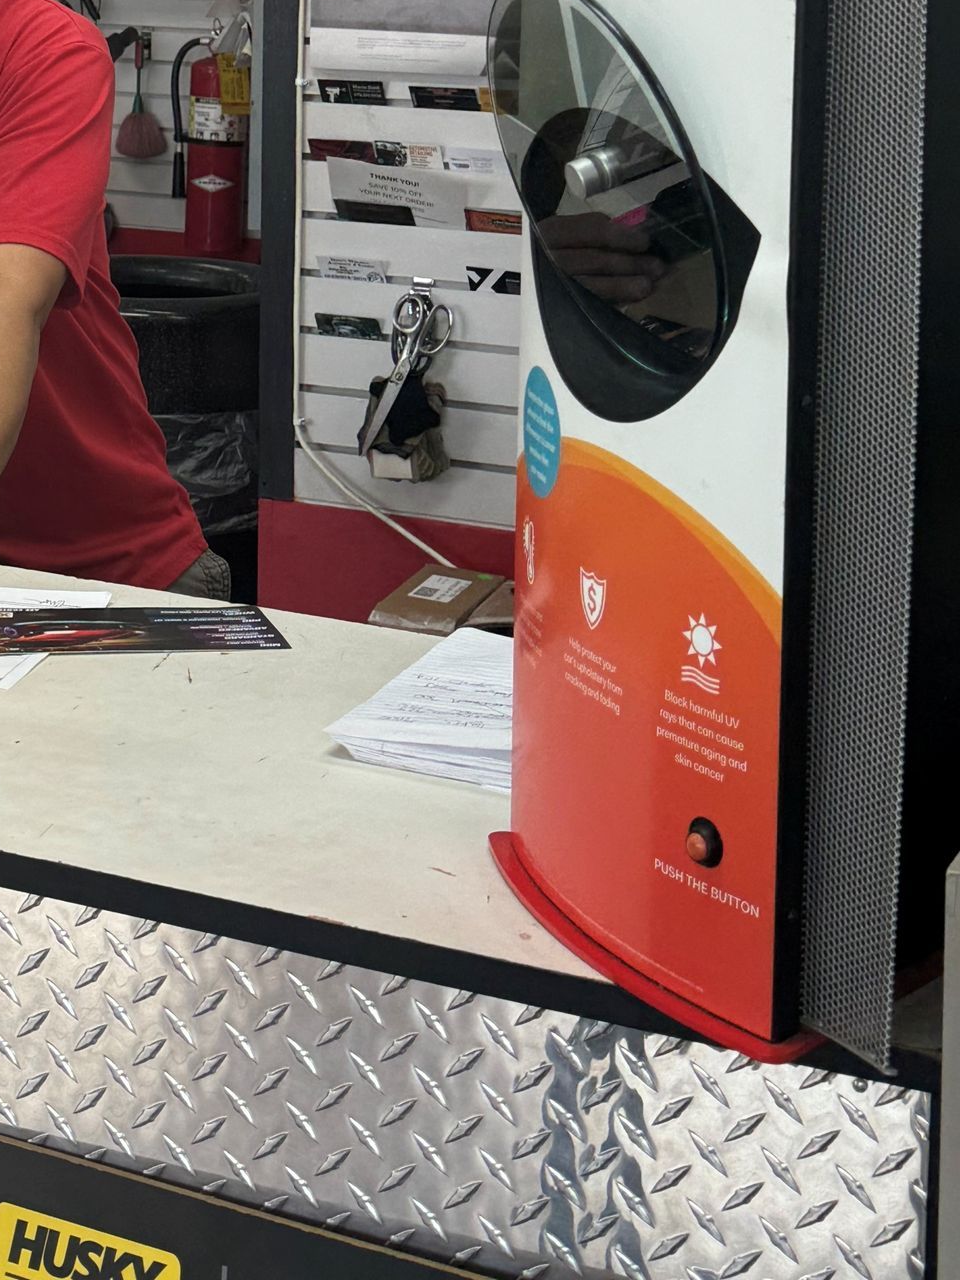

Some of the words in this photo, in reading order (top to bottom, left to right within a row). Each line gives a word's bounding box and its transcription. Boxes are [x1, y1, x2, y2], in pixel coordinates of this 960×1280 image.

[660, 708, 678, 723] rays
[678, 716, 697, 731] that
[698, 726, 714, 739] can
[716, 733, 744, 751] cause
[664, 689, 689, 709] Block
[689, 700, 724, 723] harmful
[726, 714, 740, 729] UV
[656, 726, 700, 753] premature
[701, 746, 727, 767] aging
[728, 758, 747, 773] and
[674, 753, 693, 769] skin
[694, 762, 725, 783] cancer
[654, 858, 684, 883] PUSH
[686, 874, 709, 895] THE
[710, 886, 760, 919] BUTTON
[8, 1218, 168, 1280] HUSKY
